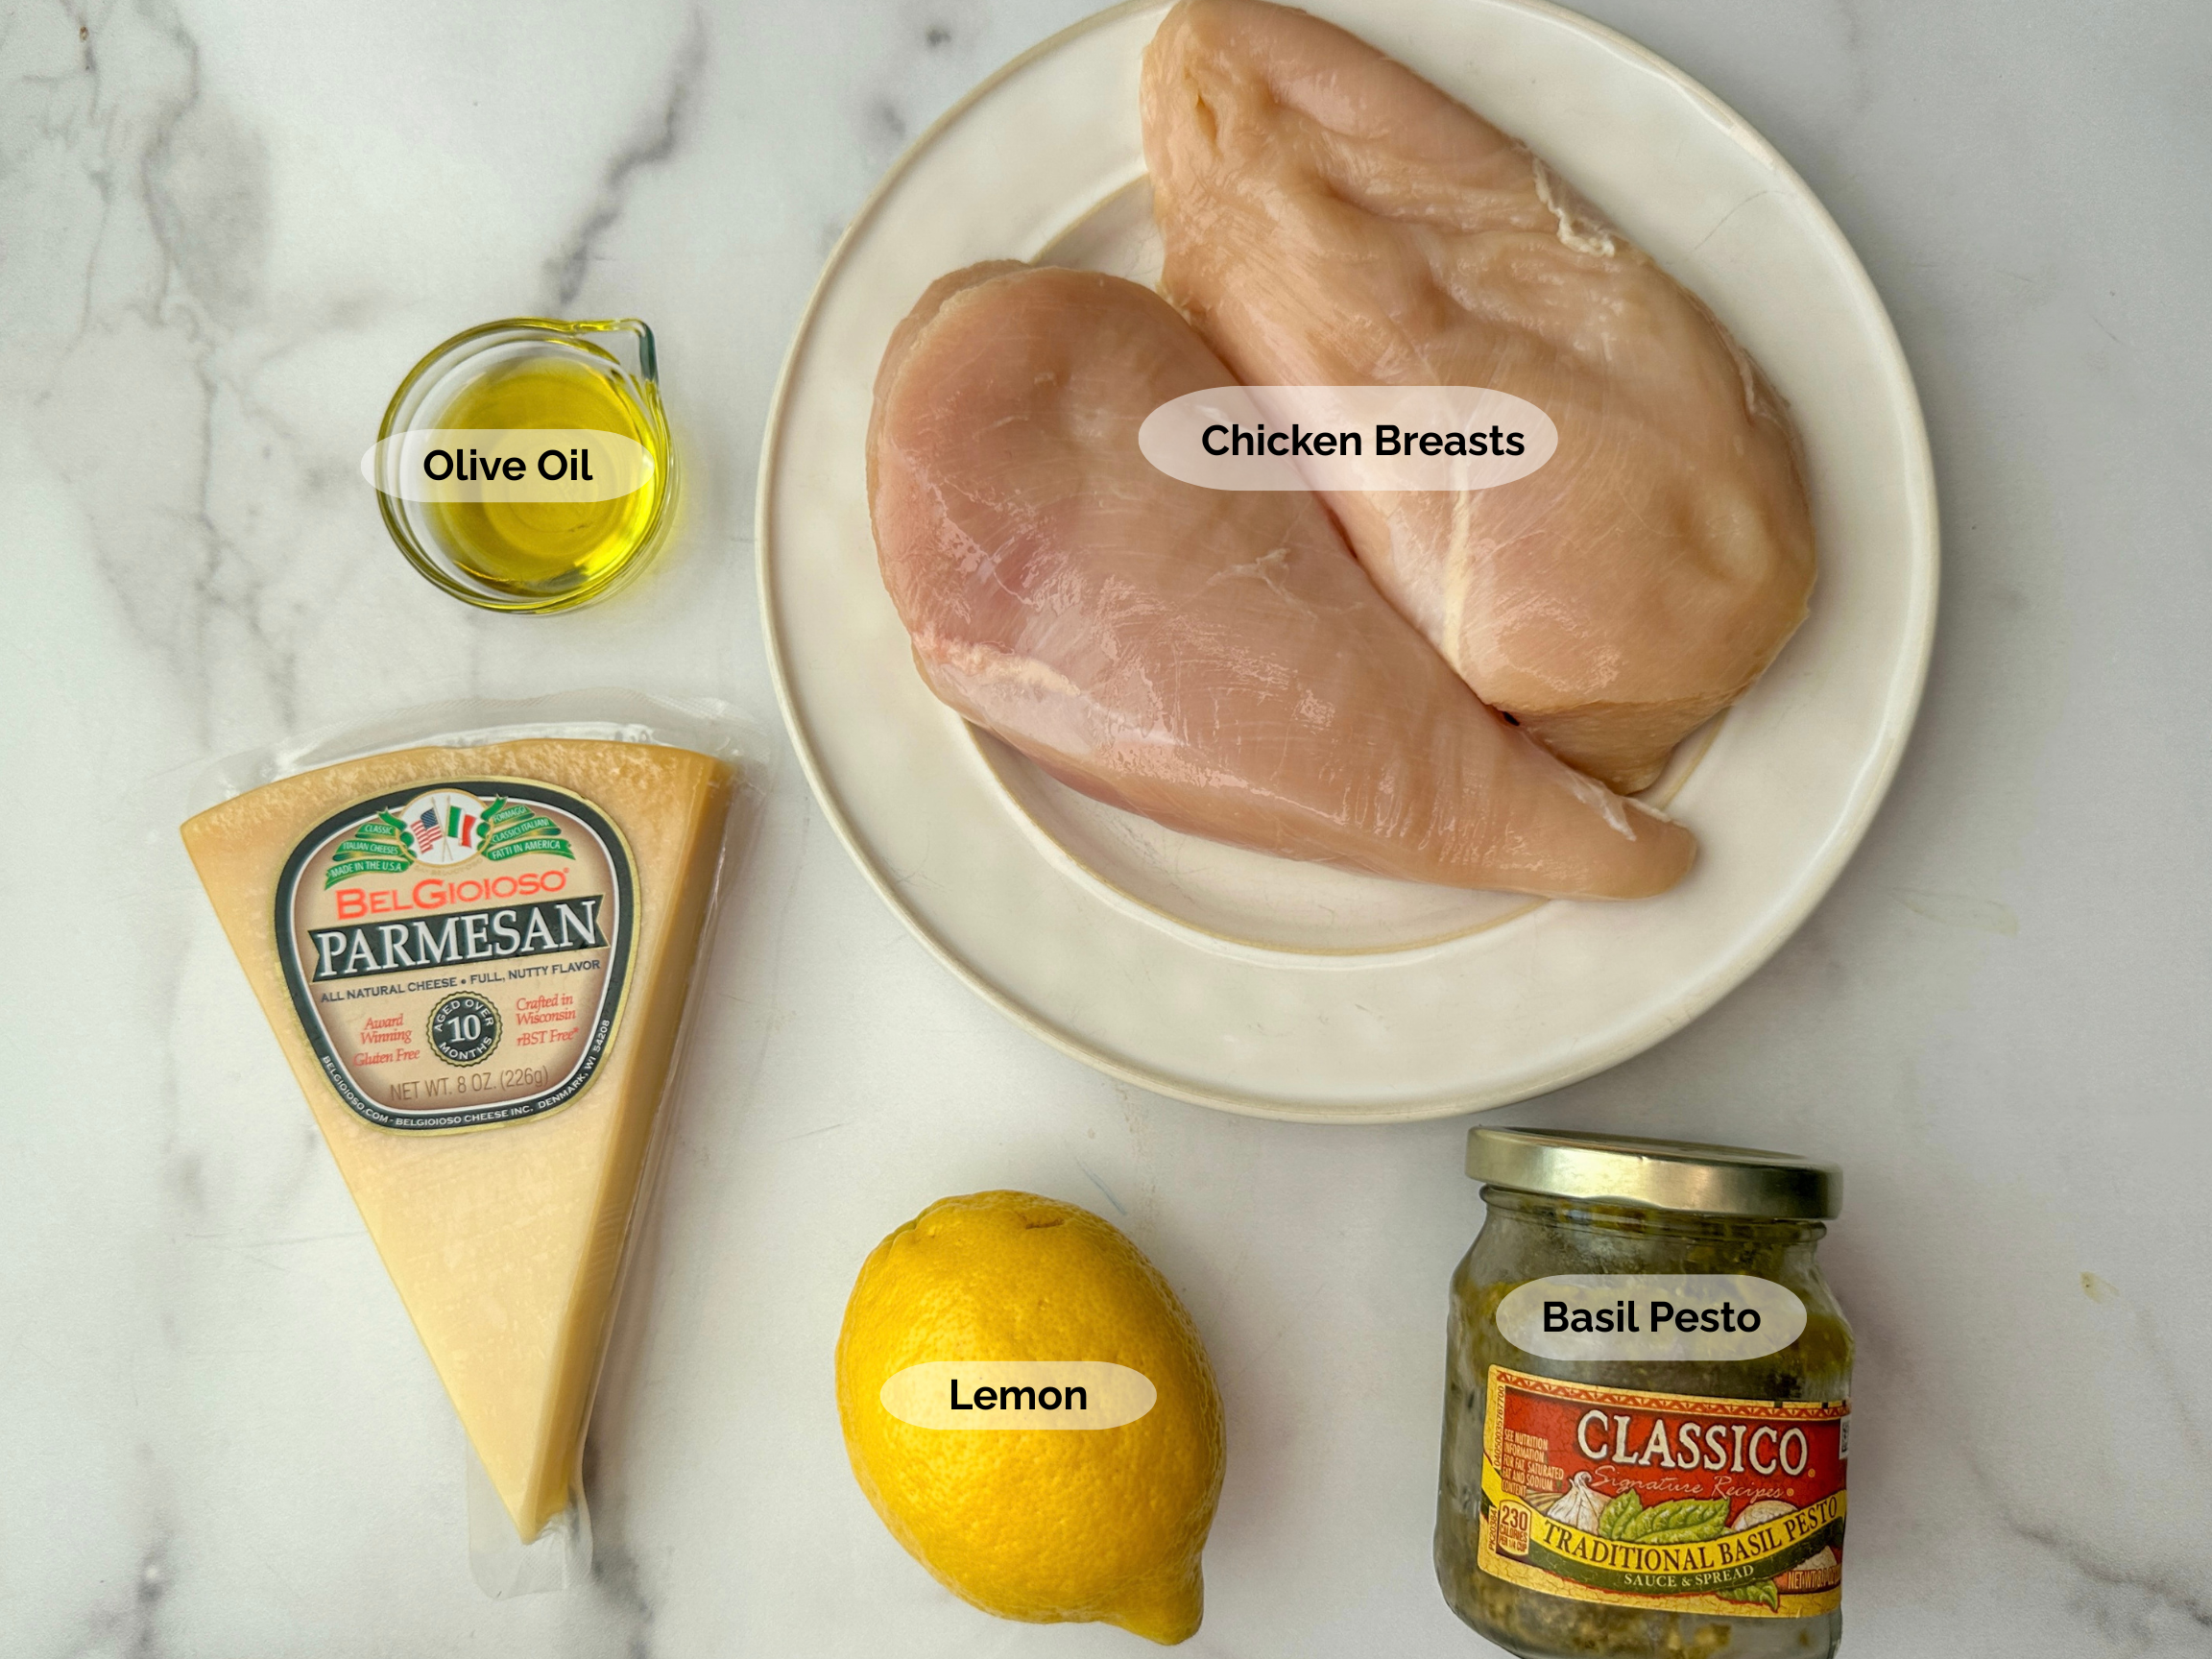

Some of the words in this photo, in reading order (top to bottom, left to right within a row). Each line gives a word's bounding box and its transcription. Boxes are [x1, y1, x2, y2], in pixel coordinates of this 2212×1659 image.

[493, 805, 527, 824] FORMAGGI
[365, 824, 393, 835] CLASSIC
[492, 827, 521, 843] CLASSICI
[520, 817, 550, 832] ITALIANI
[343, 840, 370, 852] ITALIAN
[370, 845, 399, 855] CHEESES
[491, 844, 514, 860] FATTI
[514, 844, 524, 854] IN
[524, 839, 561, 851] AMERICA
[330, 862, 354, 878] MADE
[354, 862, 365, 871] IN
[366, 860, 381, 871] THE
[316, 899, 596, 977] PARMESAN
[321, 992, 345, 1004] ALL
[347, 983, 405, 1000] NATURAL
[407, 976, 458, 993] CHEESE
[469, 973, 506, 985] FULL,
[508, 966, 549, 980] NUTTY
[551, 959, 601, 974] FLAVOR
[516, 993, 559, 1013] Crafted
[561, 993, 574, 1005] in
[364, 1013, 404, 1031] Award
[434, 999, 461, 1032] AGED
[465, 998, 494, 1026] OVER
[515, 1007, 577, 1026] Wisconsin
[360, 1028, 413, 1045] Winning
[447, 1014, 481, 1043] 10
[517, 1030, 548, 1046] rBST
[352, 1052, 394, 1068] Gluten
[396, 1047, 421, 1062] Free
[440, 1036, 493, 1060] MONTHS
[323, 1056, 389, 1123] BELGIOIOSO.COM
[396, 1116, 462, 1126] BELGIOIOSO
[464, 1109, 509, 1122] CHEESE
[538, 1072, 589, 1109] DENMARK,
[584, 1055, 597, 1071] WI
[592, 1020, 611, 1053] 54208
[390, 1081, 421, 1101] NET
[424, 1076, 453, 1097] WT.
[457, 1075, 467, 1094] 8
[471, 1072, 496, 1092] OZ.
[500, 1065, 549, 1092] (226g)
[1503, 1428, 1515, 1442] SEE
[1514, 1431, 1549, 1451] NUTRITION
[1577, 1408, 1809, 1476] CLASSICO
[1503, 1441, 1546, 1463] INFORMATION
[1503, 1453, 1515, 1467] FOR
[1527, 1459, 1565, 1480] SATURATED
[1502, 1466, 1513, 1479] FAT
[1512, 1471, 1526, 1484] AND
[1526, 1474, 1553, 1491] SODIUM
[1502, 1479, 1527, 1498] CONTENT
[1589, 1464, 1704, 1495] Signature
[1710, 1475, 1785, 1503] Recipes
[1501, 1504, 1528, 1531] 230
[1499, 1524, 1528, 1544] CALORIES
[1543, 1519, 1715, 1573] TRADITIONAL
[1719, 1527, 1782, 1567] BASIL
[1783, 1496, 1839, 1534] PESTO
[1623, 1572, 1677, 1588] SAUCE
[1681, 1577, 1692, 1587] &
[1695, 1564, 1754, 1586] SPREAD
[1788, 1571, 1804, 1590] NET
